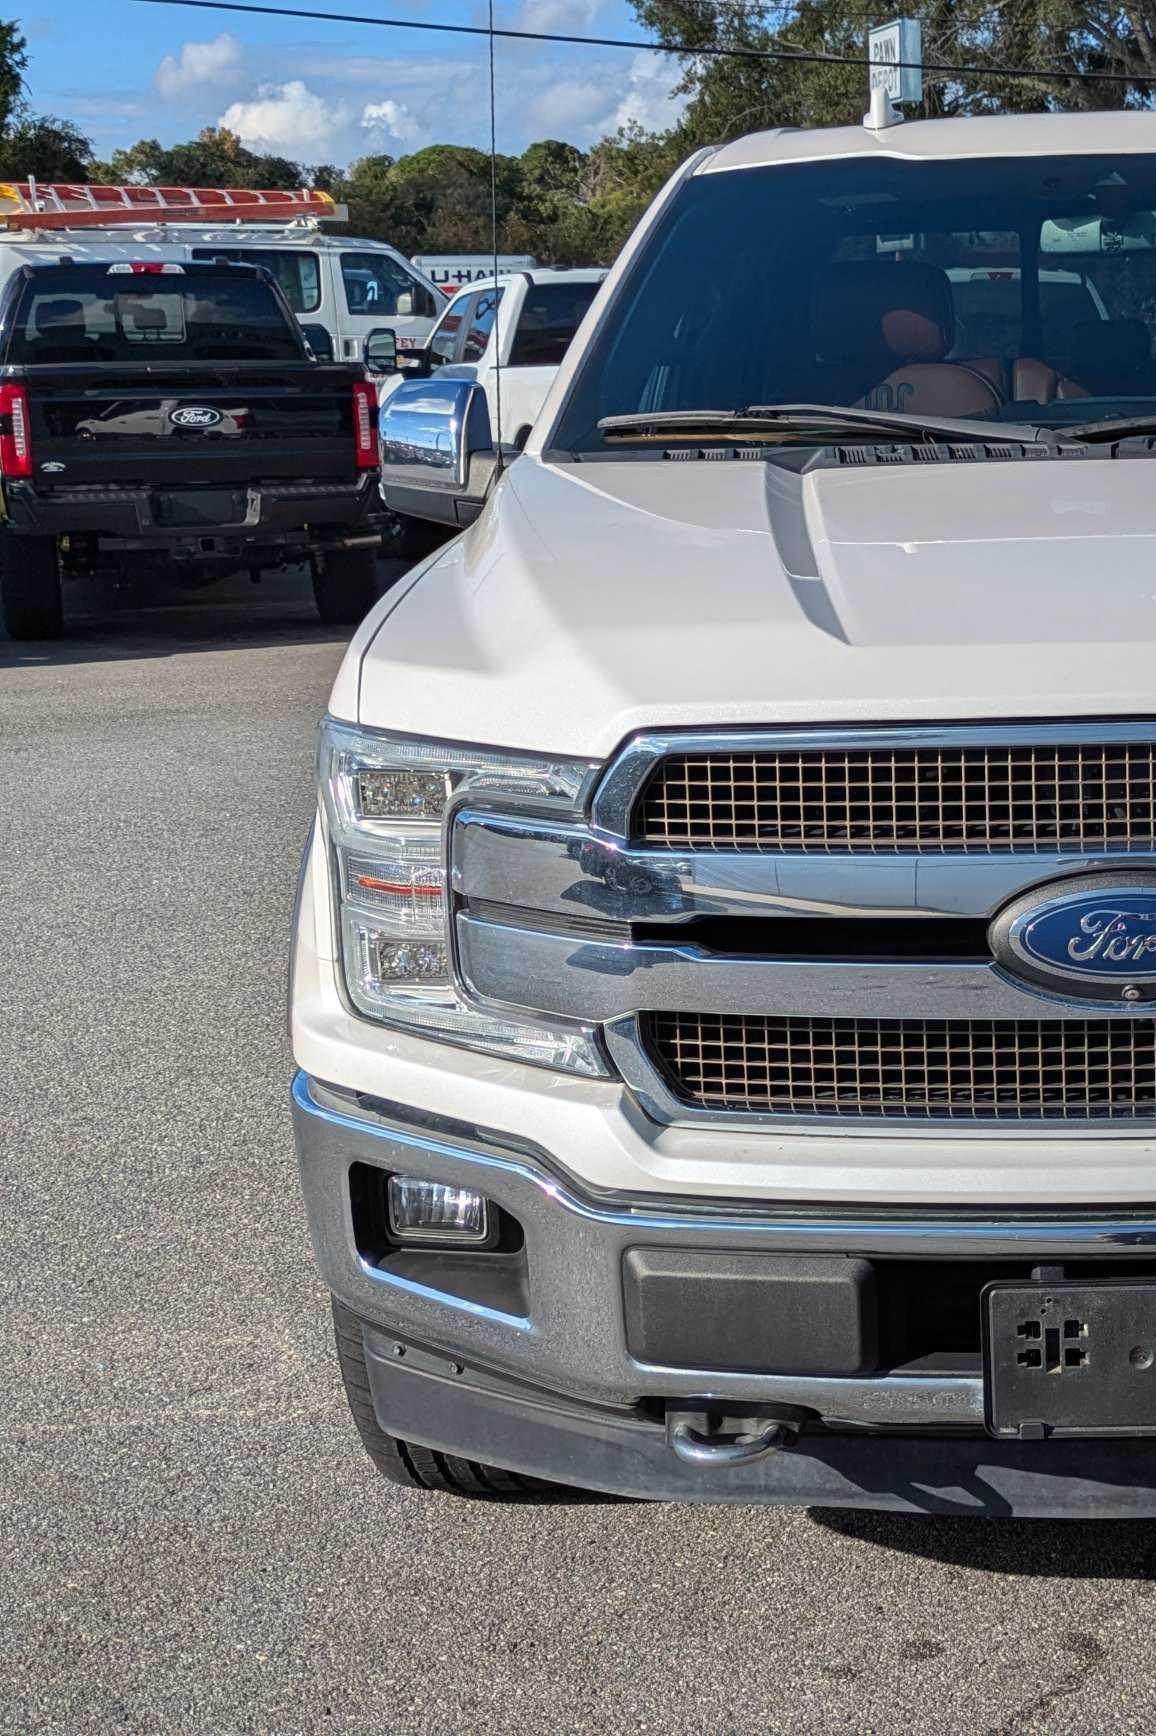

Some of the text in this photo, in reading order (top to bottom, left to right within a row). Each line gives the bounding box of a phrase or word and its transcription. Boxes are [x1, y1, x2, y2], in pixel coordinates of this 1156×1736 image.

[873, 38, 896, 62] PAWN
[430, 269, 512, 284] U-HA
[180, 409, 212, 424] Ford
